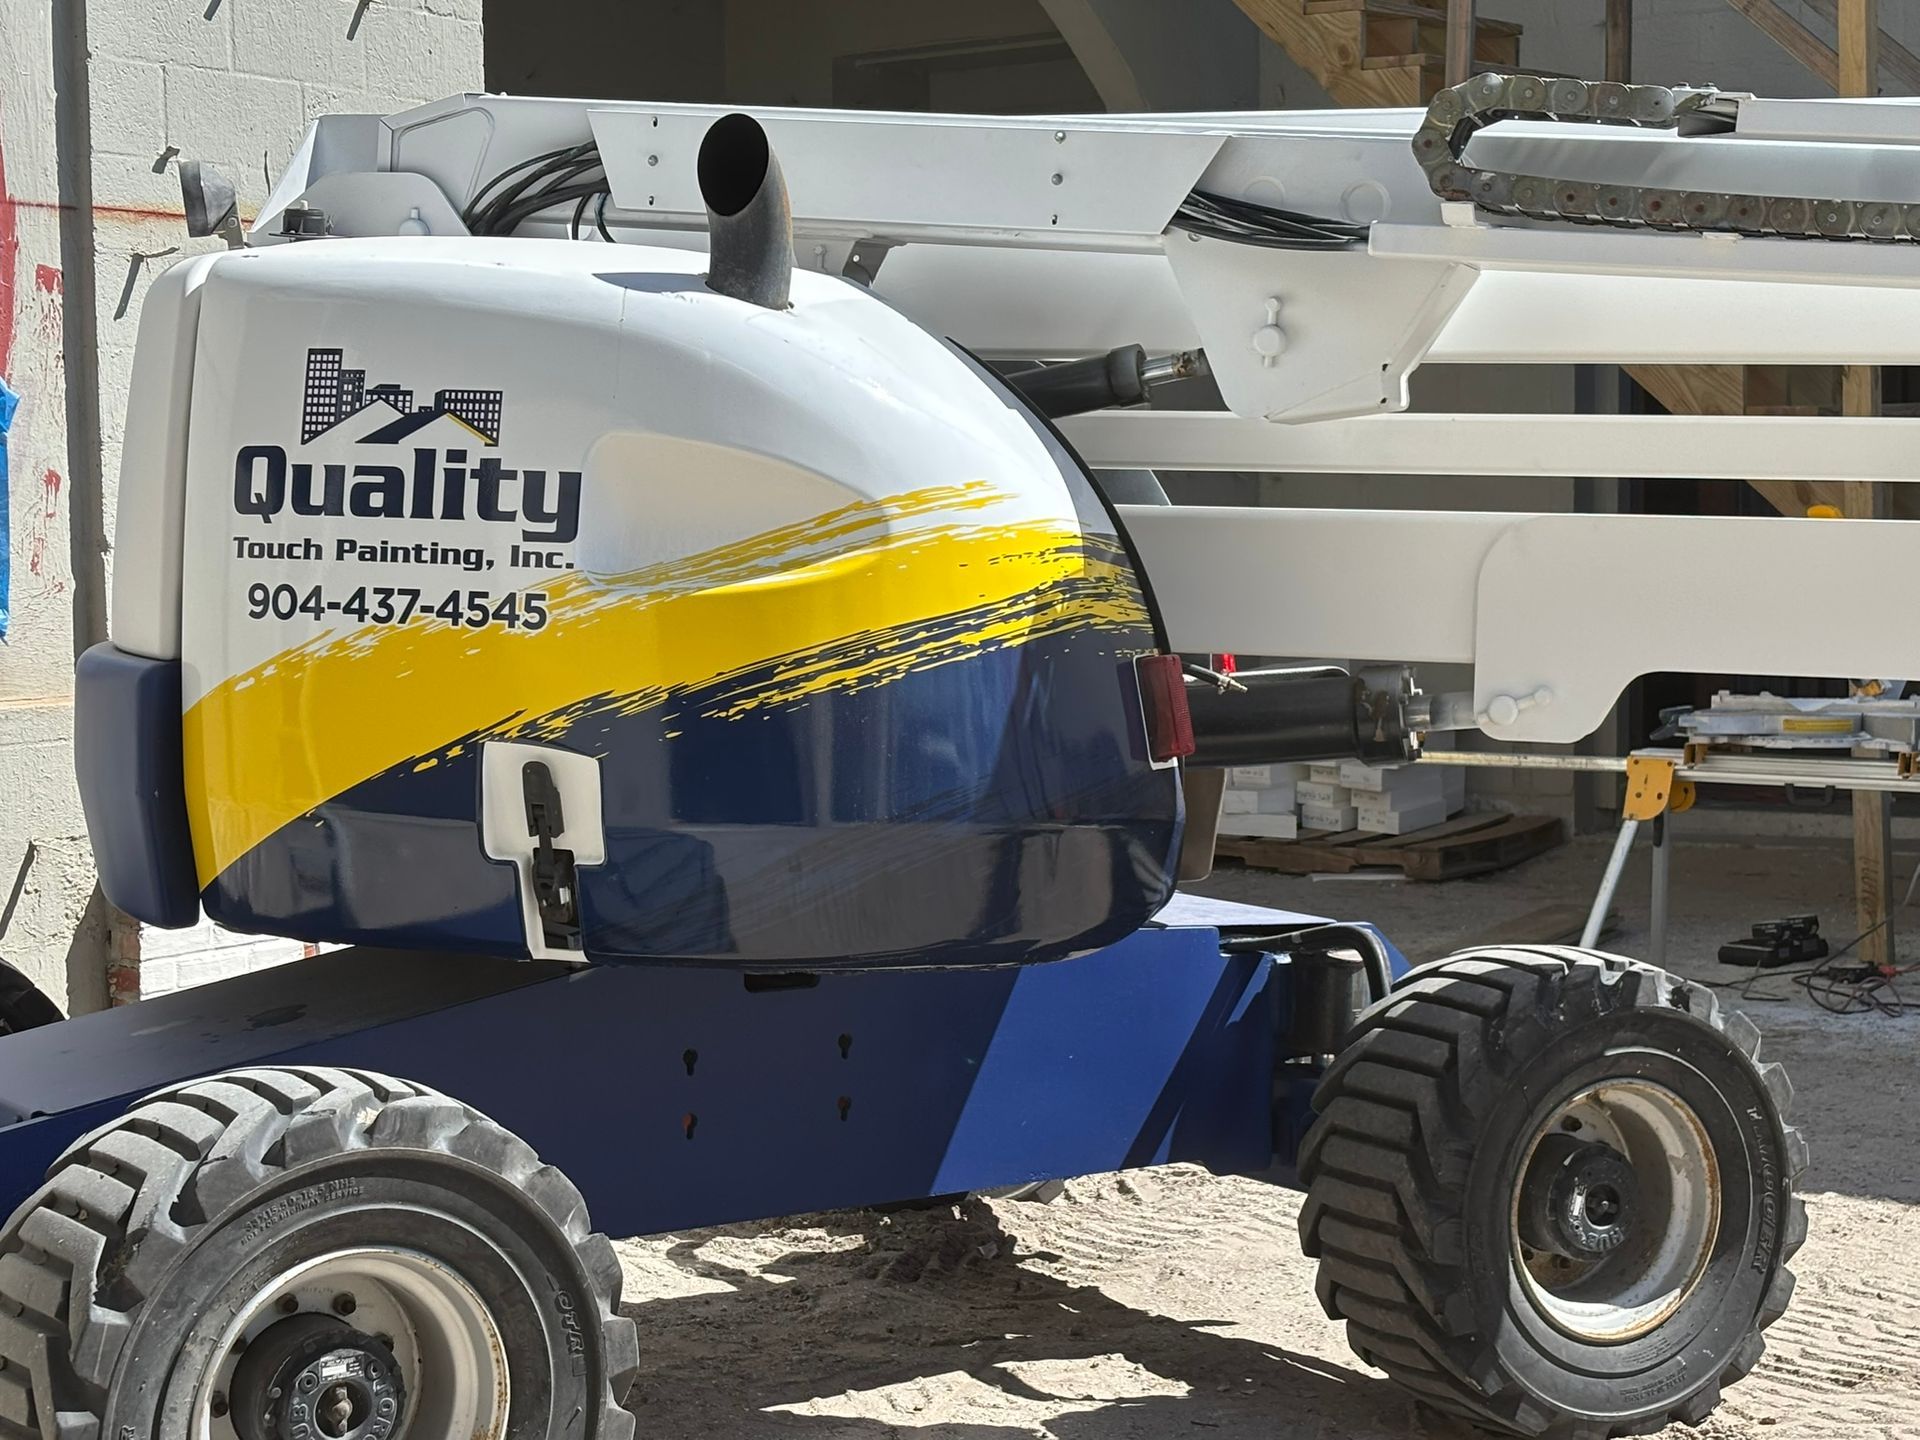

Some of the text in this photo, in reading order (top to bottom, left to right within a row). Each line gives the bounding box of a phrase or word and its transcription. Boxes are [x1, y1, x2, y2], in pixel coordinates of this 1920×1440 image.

[234, 445, 582, 543] Quality
[233, 536, 575, 571] Touch Painting, Inc.
[247, 582, 547, 630] 904-437-4545
